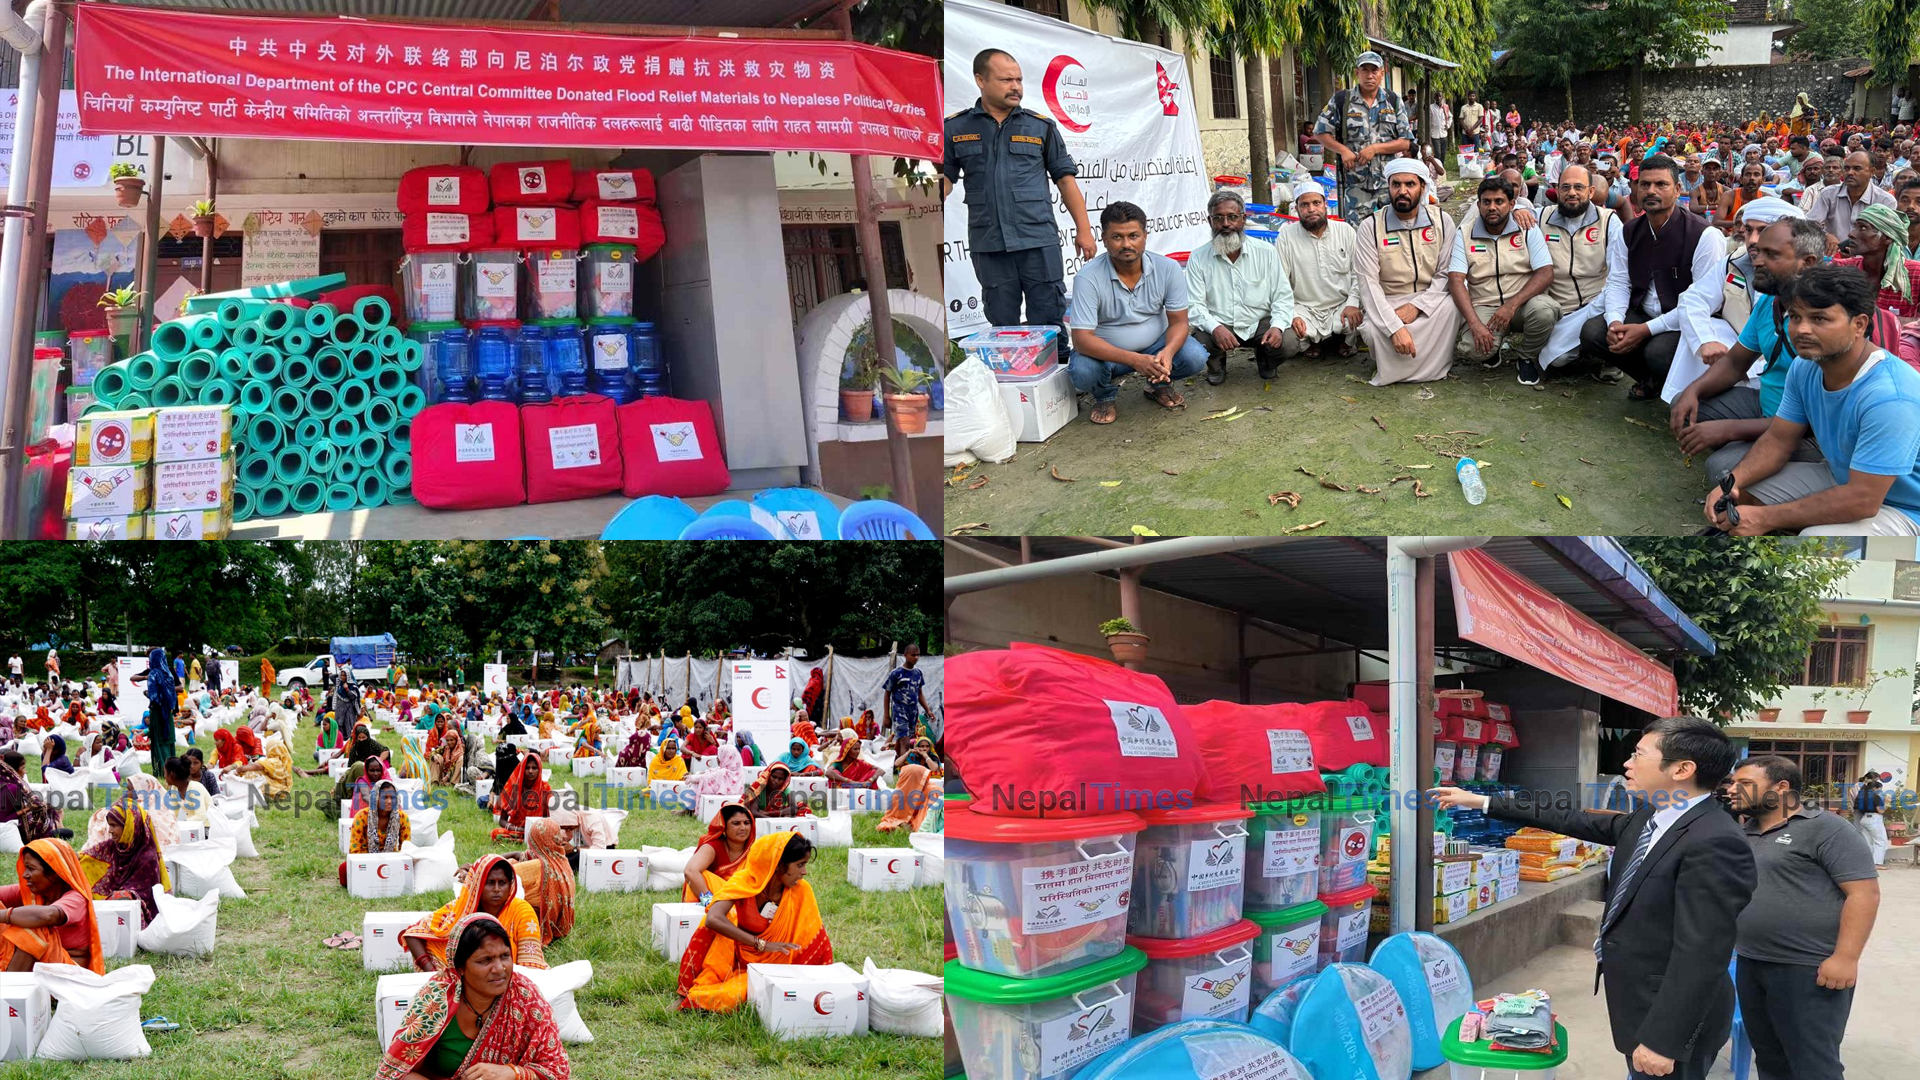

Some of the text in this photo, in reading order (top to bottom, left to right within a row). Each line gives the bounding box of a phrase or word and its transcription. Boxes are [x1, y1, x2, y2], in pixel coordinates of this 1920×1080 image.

[228, 37, 836, 79] 中共中央对外联络部向尼泊尔政党捐赠抗洪救灾物资
[104, 64, 926, 117] The International Department of the CPC Central Committee Donated Flood Relief Materials to Nepalese Political Parties
[83, 92, 134, 112] चिनियाँ
[209, 98, 237, 117] पार्टी
[293, 103, 350, 121] समितिको
[429, 108, 476, 126] विभागले
[483, 111, 531, 128] नेपालका
[537, 112, 596, 129] राजनीतिक
[669, 115, 693, 131] बाढी
[698, 115, 746, 132] पीडितका
[752, 116, 777, 132] लागि
[783, 121, 810, 133] राहत
[816, 117, 852, 133] सामग्री
[1184, 211, 1208, 227] NEPA
